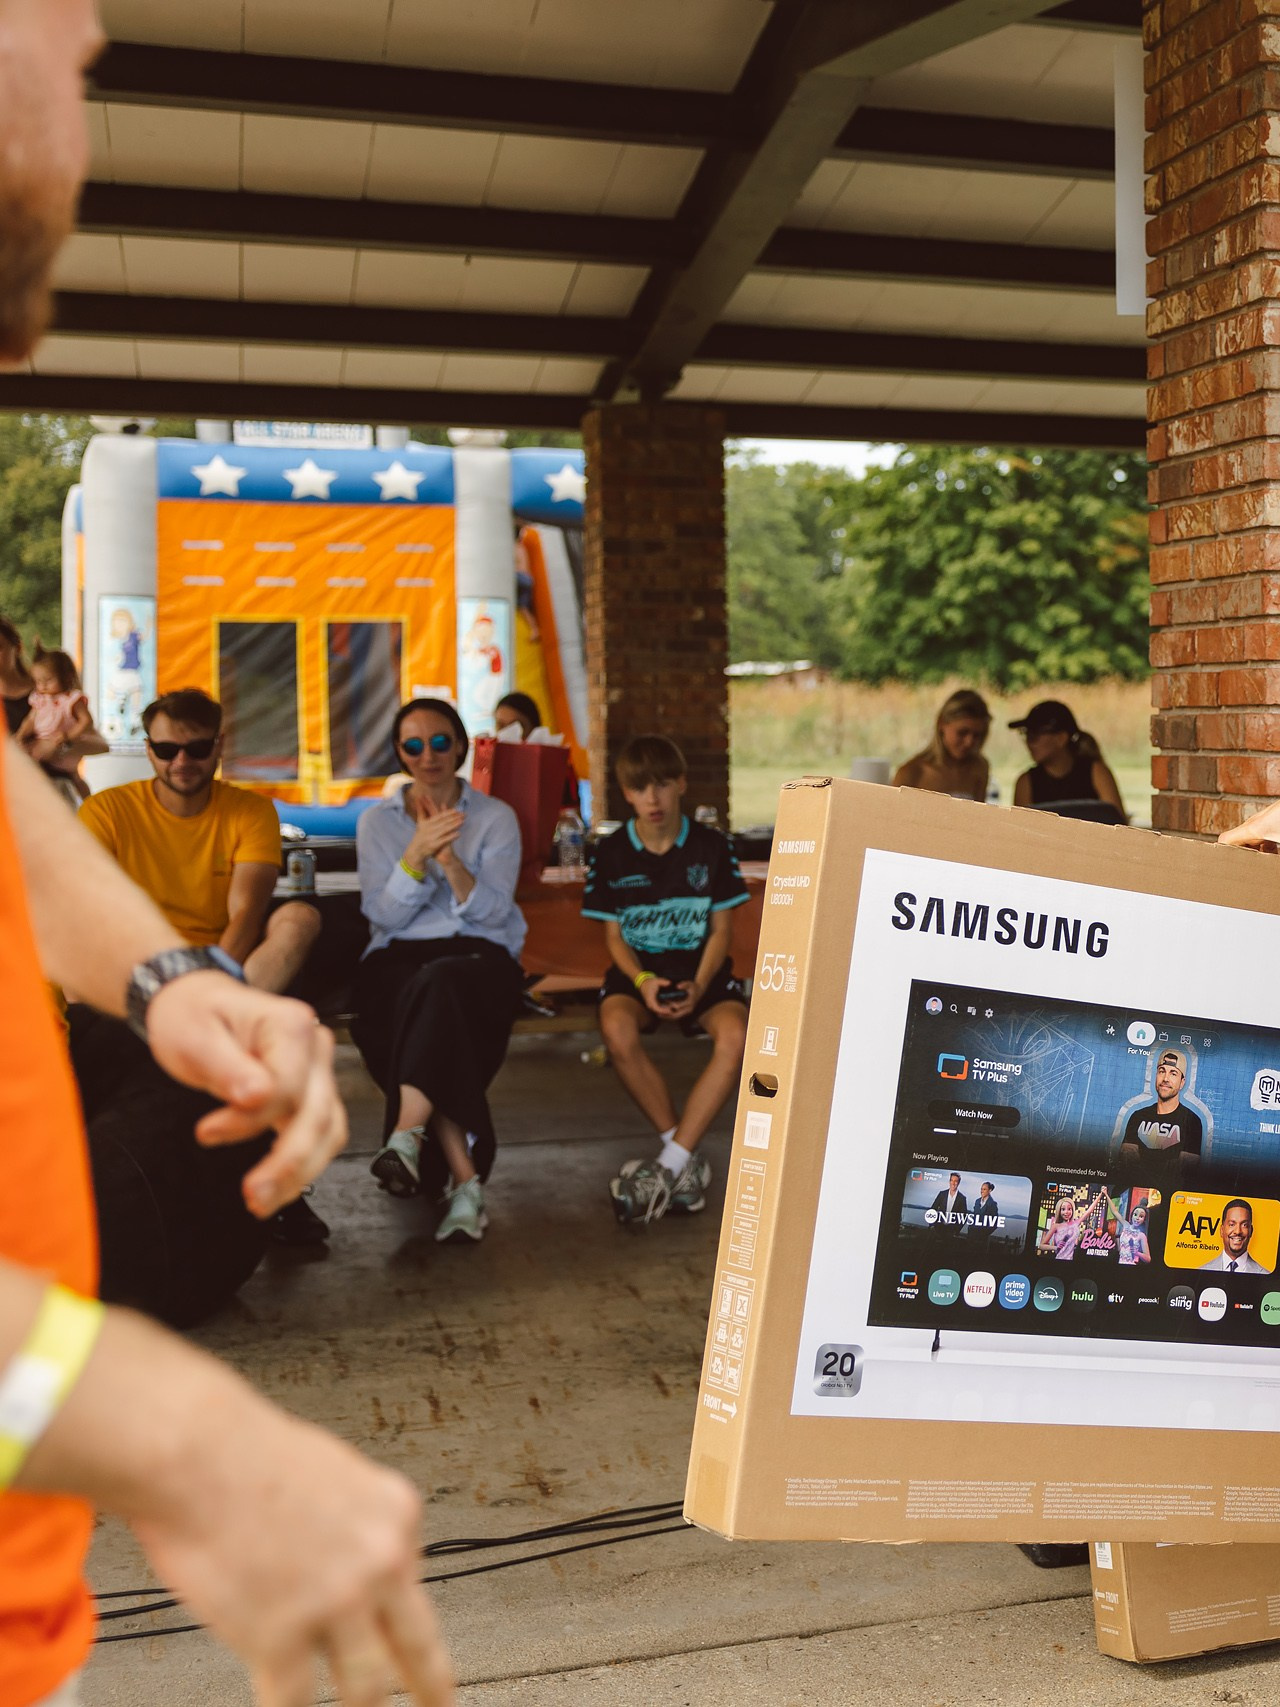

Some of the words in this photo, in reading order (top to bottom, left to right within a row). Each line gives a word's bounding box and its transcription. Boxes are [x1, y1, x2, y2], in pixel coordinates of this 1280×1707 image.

[778, 841, 815, 853] SAMSUNG
[773, 876, 796, 890] Crystal
[797, 876, 810, 887] UHD
[892, 892, 1109, 958] SAMSUNG
[1128, 1047, 1137, 1055] For
[1138, 1048, 1150, 1056] You
[973, 1058, 1022, 1074] Samsung
[972, 1070, 986, 1081] TV
[987, 1071, 1008, 1083] Plus
[955, 1109, 976, 1119] Watch
[977, 1111, 993, 1120] Now
[1138, 1121, 1180, 1142] NASA
[1260, 1123, 1275, 1133] THINK
[927, 1154, 948, 1163] Playing
[1046, 1165, 1087, 1175] Recommended
[938, 1211, 974, 1225] NEWS
[974, 1214, 1006, 1228] LIVE
[1179, 1211, 1220, 1238] AFV
[1080, 1229, 1115, 1249] Barbie
[1200, 1243, 1219, 1251] Ribeiro
[967, 1285, 993, 1294] NETFLIX
[1005, 1281, 1025, 1290] prime
[1005, 1288, 1024, 1297] video
[1071, 1291, 1094, 1301] hulu
[1170, 1298, 1193, 1310] sling
[822, 1351, 855, 1377] 20
[703, 1393, 721, 1411] FRONT
